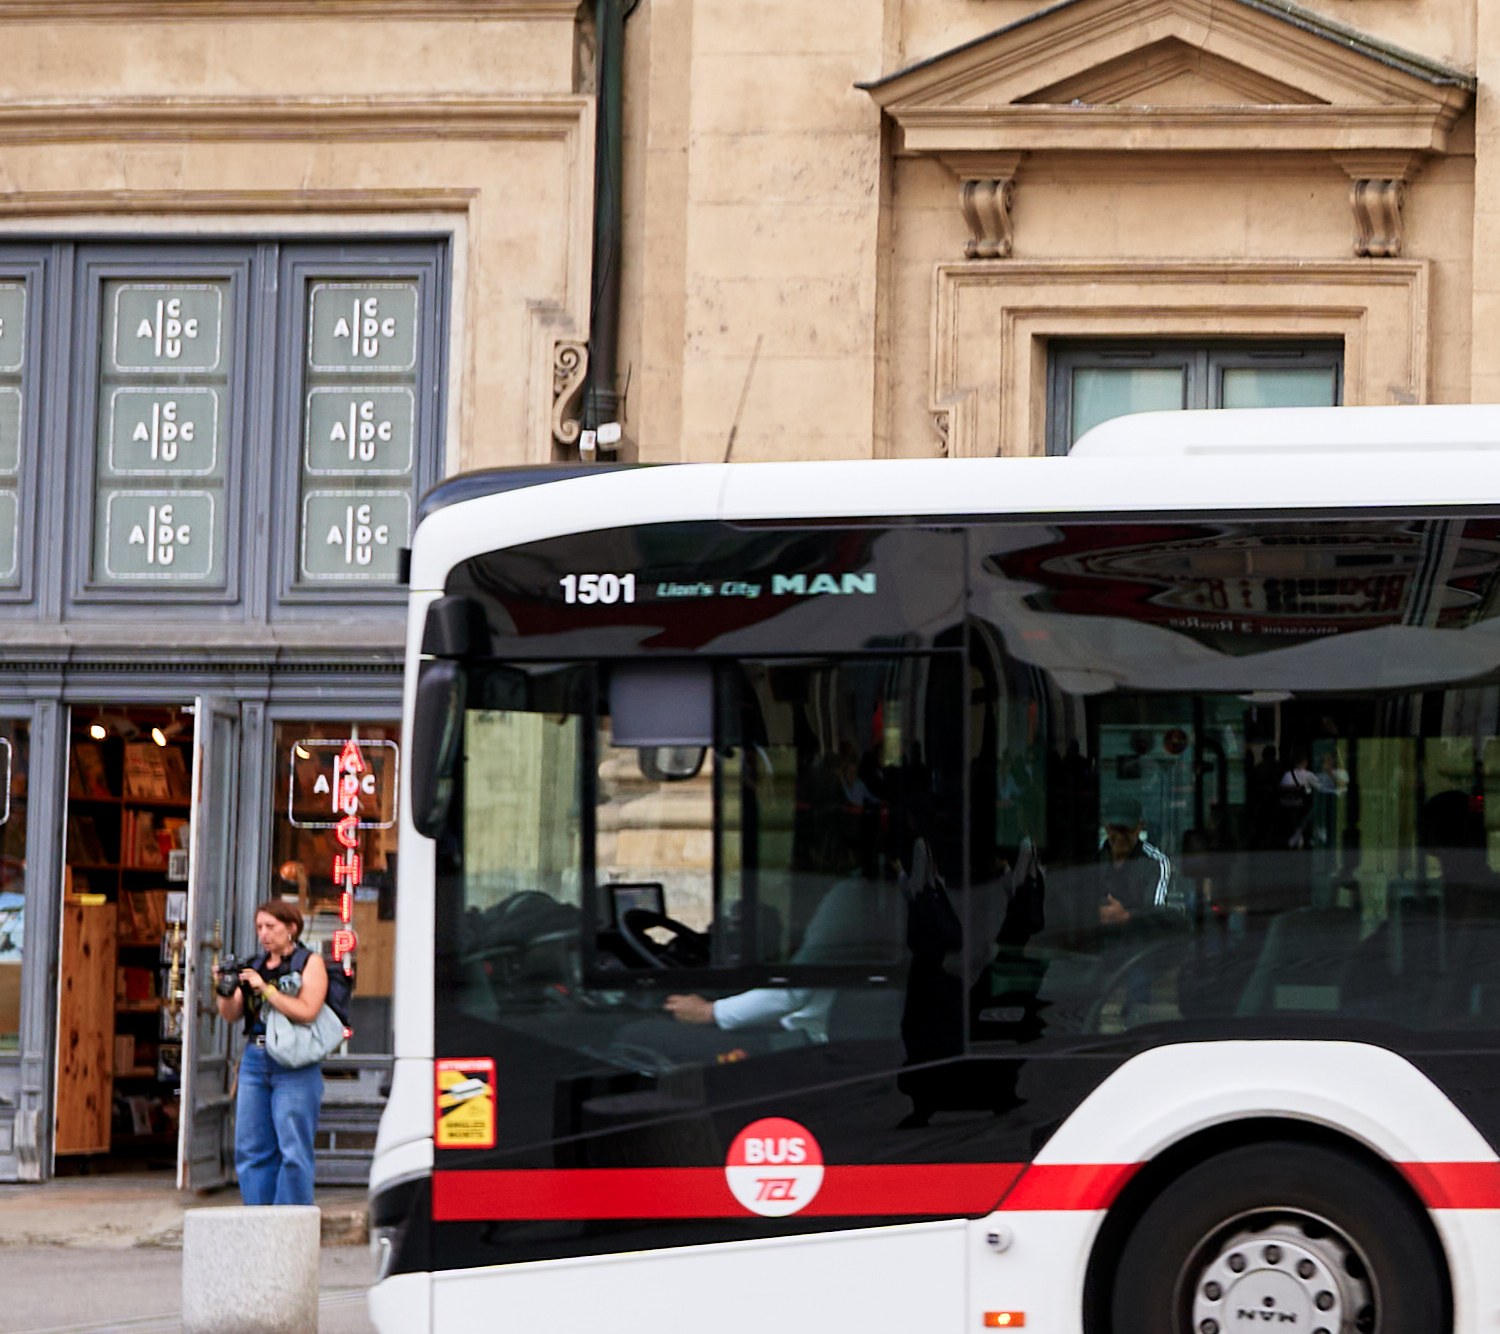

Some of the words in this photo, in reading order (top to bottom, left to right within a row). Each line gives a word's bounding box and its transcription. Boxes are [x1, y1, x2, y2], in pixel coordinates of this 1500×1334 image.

[559, 573, 636, 604] 1501
[719, 581, 762, 599] City
[771, 572, 877, 595] MAN
[745, 1137, 806, 1164] BUS
[1237, 1309, 1297, 1323] MAN
